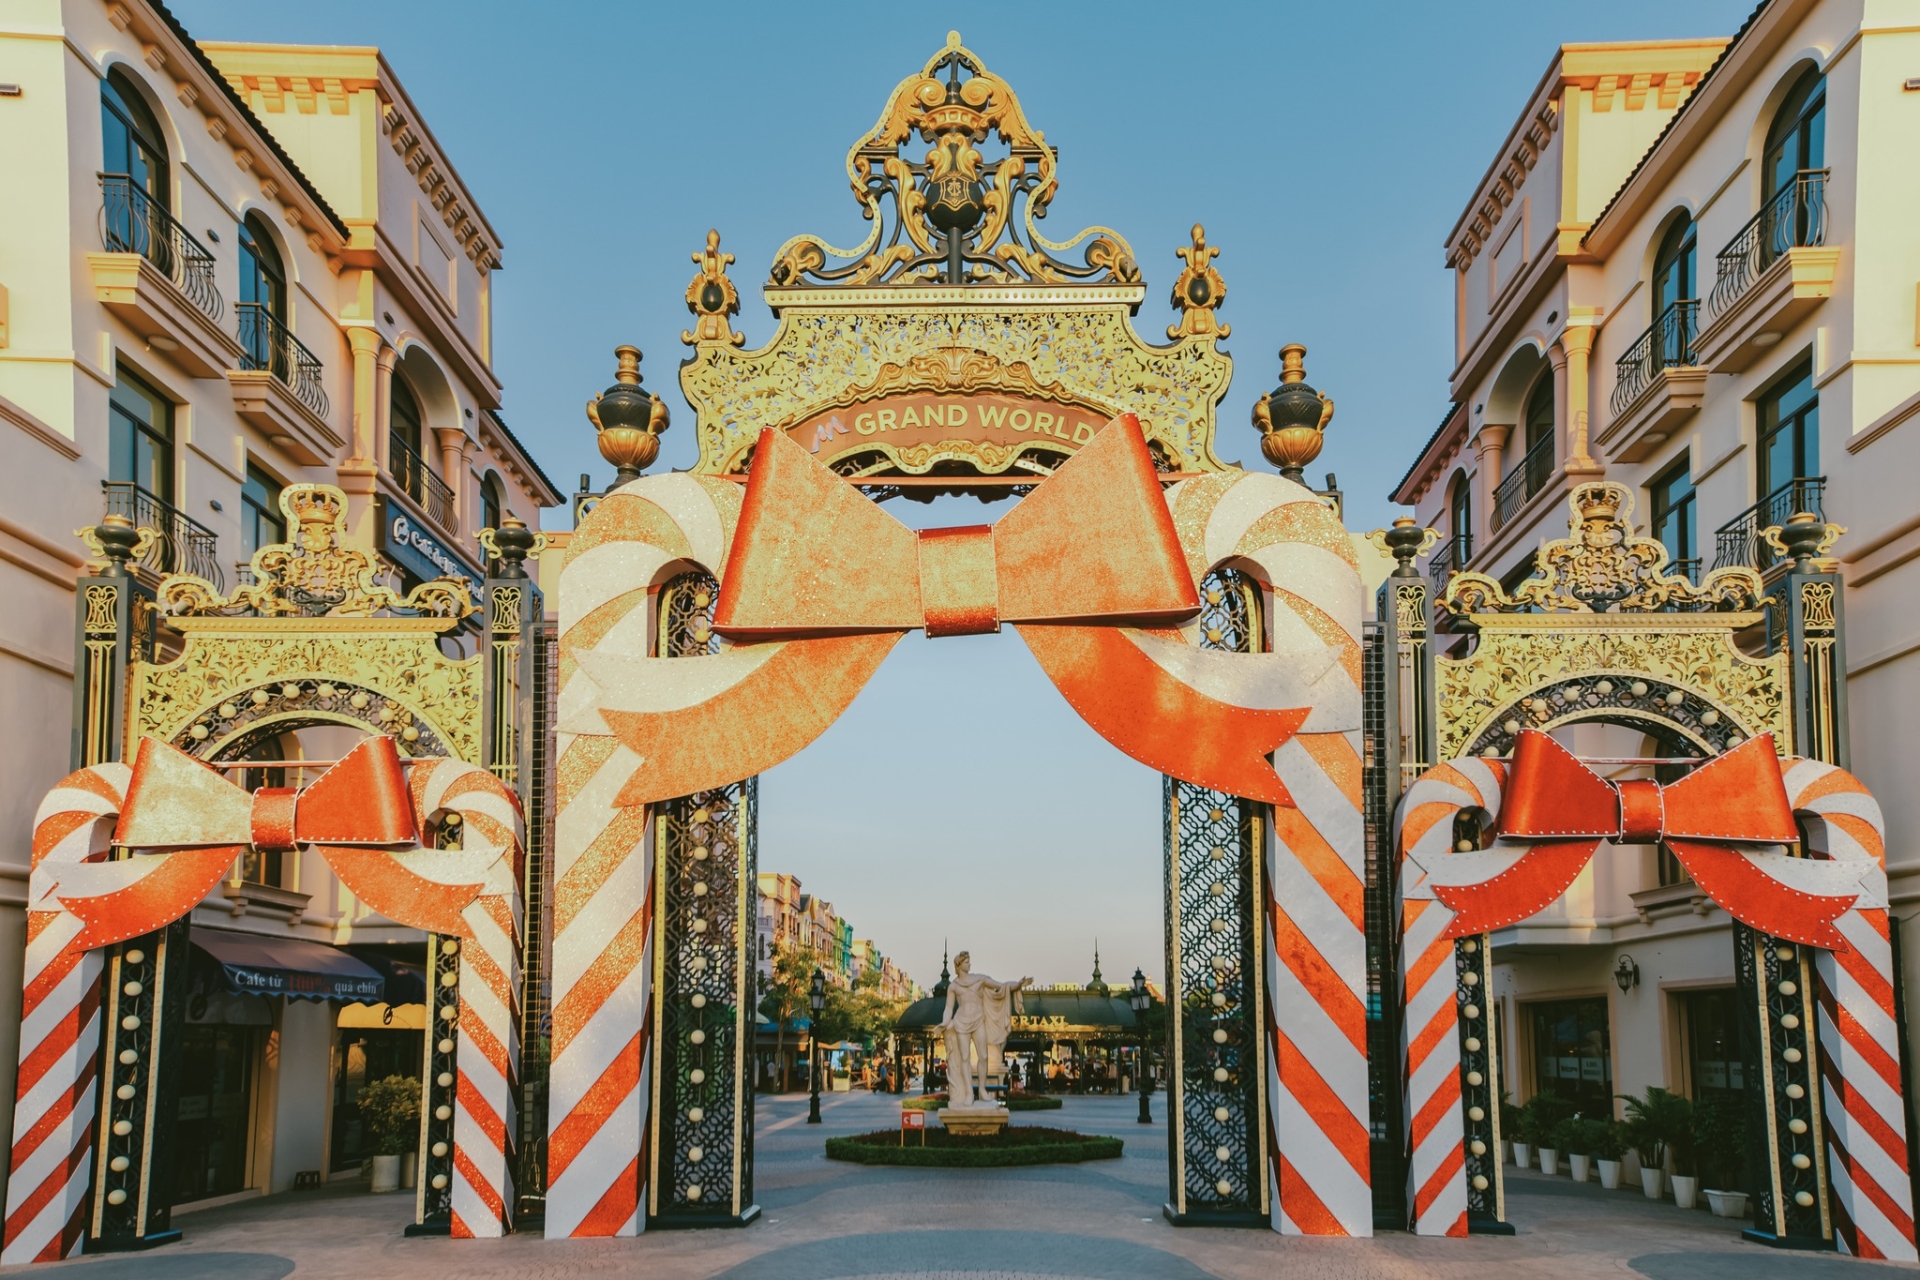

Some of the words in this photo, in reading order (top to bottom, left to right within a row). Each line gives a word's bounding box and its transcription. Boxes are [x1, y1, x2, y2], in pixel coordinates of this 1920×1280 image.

[854, 404, 968, 436] GRAND
[977, 404, 1095, 446] WORLD
[411, 531, 433, 560] Café
[235, 971, 266, 988] Cafe
[289, 974, 331, 993] 100%
